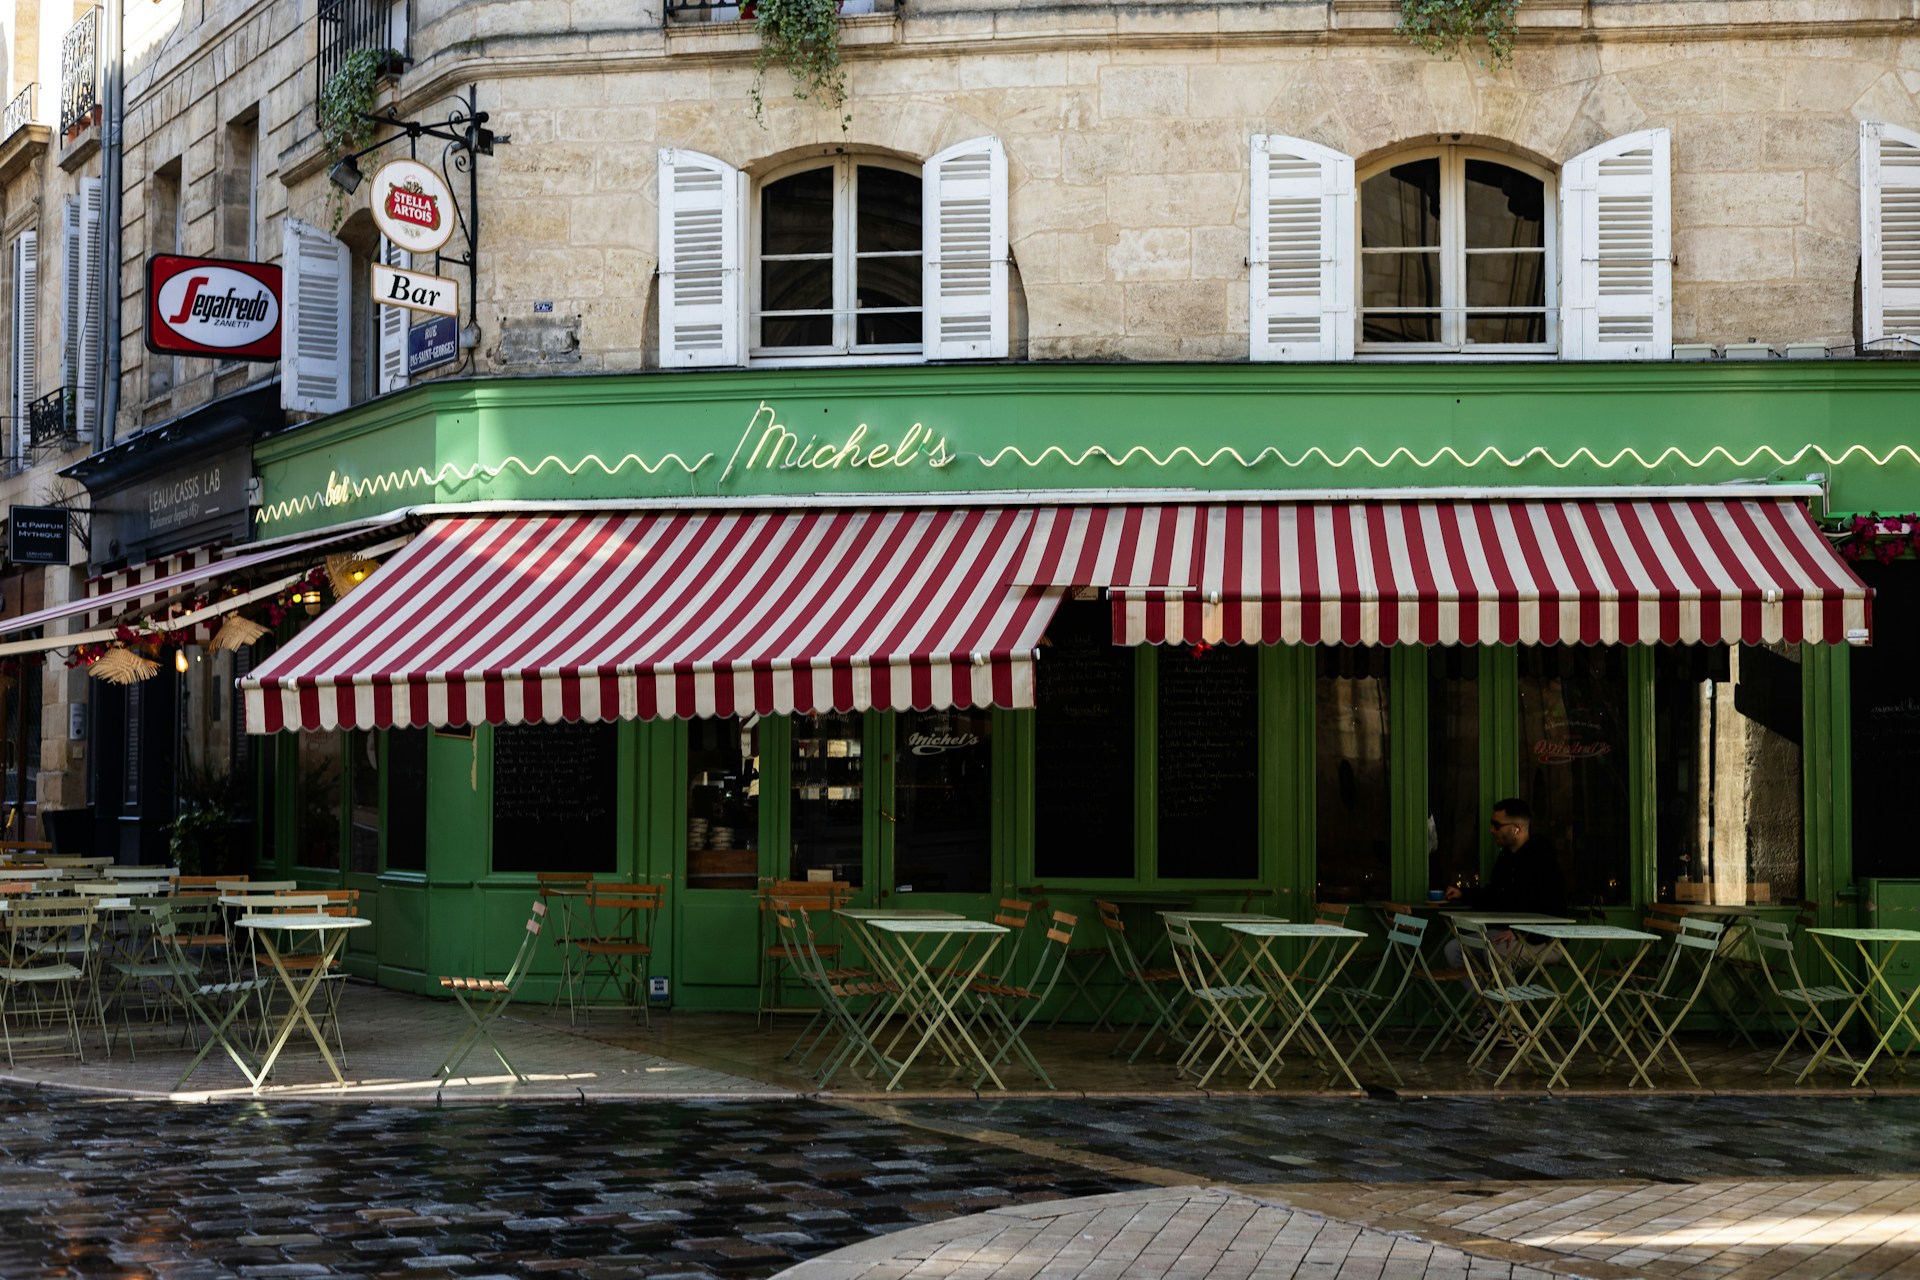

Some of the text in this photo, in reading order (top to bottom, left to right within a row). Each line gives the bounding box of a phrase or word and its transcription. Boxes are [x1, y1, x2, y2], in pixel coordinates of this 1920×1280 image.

[393, 191, 432, 211] STELLA
[393, 204, 433, 223] ARTOIS
[168, 276, 269, 324] Segafredo
[387, 274, 441, 306] Bar
[213, 319, 250, 328] ZANETTI
[424, 325, 438, 340] RUE
[409, 341, 455, 367] PAS-SAINT-GEORGES
[720, 400, 957, 482] Michel's
[174, 476, 200, 504] CASSIS
[204, 468, 221, 495] LAB
[174, 505, 188, 526] depuis
[909, 732, 980, 754] Michel's
